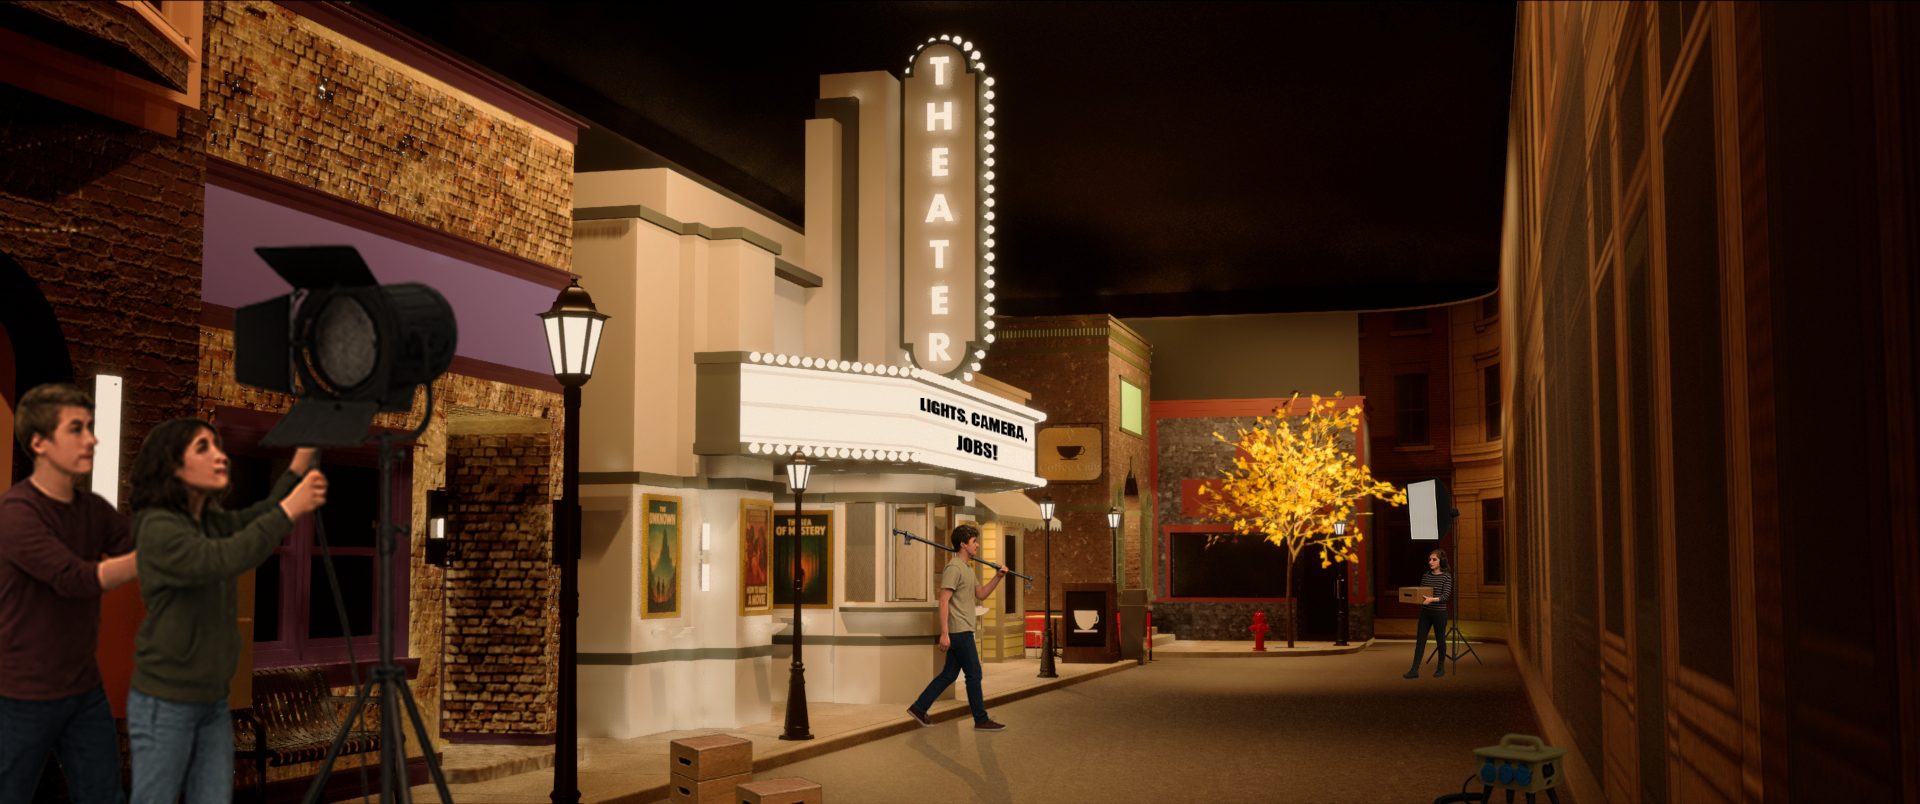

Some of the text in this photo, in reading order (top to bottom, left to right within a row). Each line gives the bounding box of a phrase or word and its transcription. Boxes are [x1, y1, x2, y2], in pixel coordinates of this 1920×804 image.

[925, 55, 954, 362] THEATER
[920, 397, 1028, 443] LIGHTS, CAMERA,
[956, 434, 998, 461] JOBS!
[1039, 462, 1074, 472] Coffee
[659, 505, 667, 513] THE
[649, 512, 676, 526] UNKNOWN
[775, 525, 826, 536] OF MSTERY
[746, 585, 767, 594] HOW TO MAKE
[752, 594, 766, 605] MOVIE
